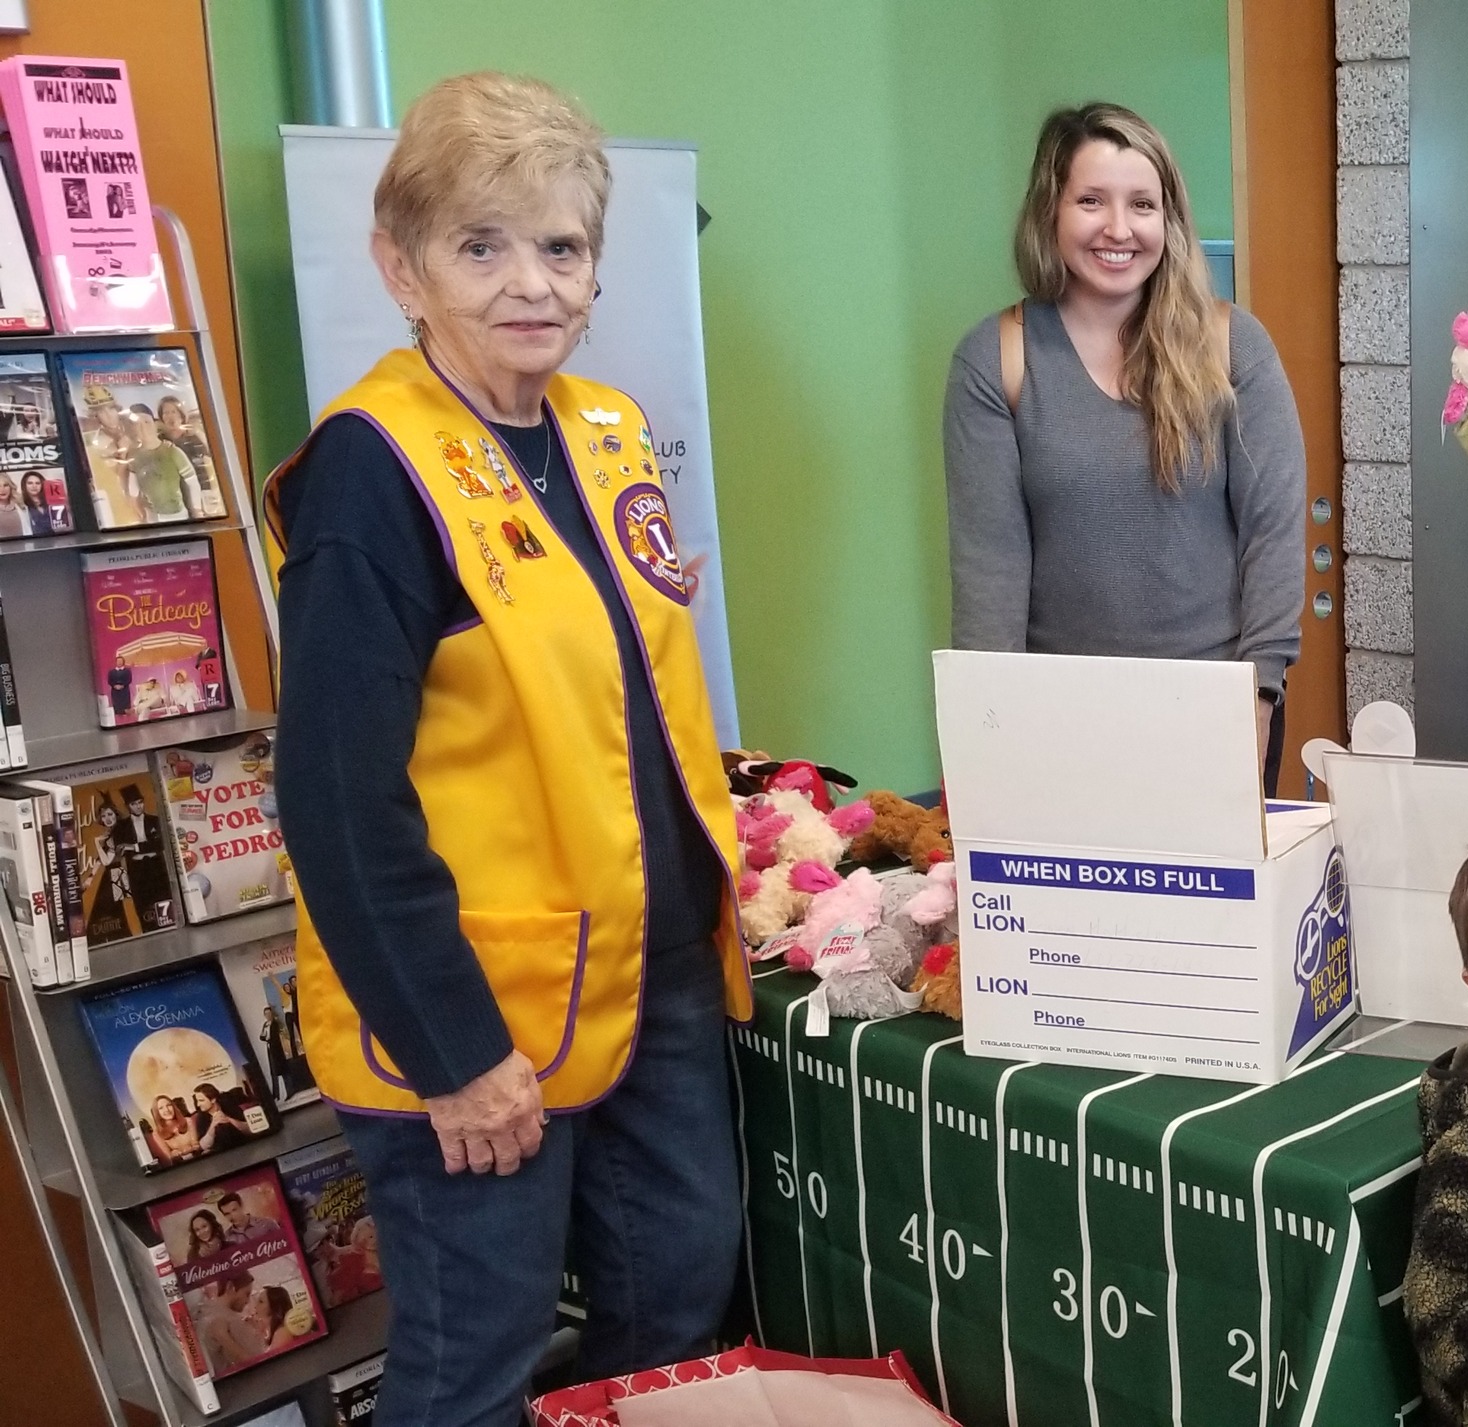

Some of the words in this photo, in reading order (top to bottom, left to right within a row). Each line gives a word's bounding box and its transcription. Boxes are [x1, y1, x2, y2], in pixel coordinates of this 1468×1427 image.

[34, 80, 68, 103] WHAT
[71, 82, 117, 104] SHOULD
[52, 506, 64, 521] 7
[630, 498, 665, 522] LIONS
[648, 523, 675, 561] L
[97, 594, 211, 630] Birdcage
[205, 663, 214, 674] R
[207, 683, 219, 697] 7
[194, 780, 265, 804] VOTE
[209, 806, 264, 833] FOR
[200, 829, 283, 864] PEDRO
[1001, 860, 1070, 881] WHEN
[1078, 865, 1128, 886] BOX
[1135, 869, 1156, 887] IS
[1163, 871, 1225, 892] FULL
[31, 891, 47, 917] BIG
[51, 876, 65, 927] DURHAM
[157, 901, 171, 917] 7
[972, 892, 1011, 911] Call
[973, 913, 1025, 932] LION
[1029, 948, 1081, 964] Phone
[1326, 933, 1347, 962] Lions
[976, 976, 1028, 996] LION
[1310, 950, 1347, 1001] RECYCLE
[1314, 996, 1328, 1021] For
[1329, 975, 1348, 1009] Sight
[115, 1012, 145, 1029] ALEX
[145, 1004, 167, 1029] &
[166, 1005, 205, 1025] EMMA
[1034, 1010, 1085, 1027] Phone
[980, 1039, 1011, 1048] EYEGLASS
[1011, 1041, 1049, 1051] COLLECTION
[1066, 1047, 1113, 1057] INTERNATIONAL
[1113, 1051, 1131, 1059] LIONS
[1184, 1056, 1223, 1068] PRINTED
[1224, 1060, 1234, 1068] IN
[1235, 1060, 1262, 1071] U.S.A.
[182, 1260, 230, 1285] Valentine
[230, 1250, 254, 1267] Ever
[256, 1238, 288, 1258] After
